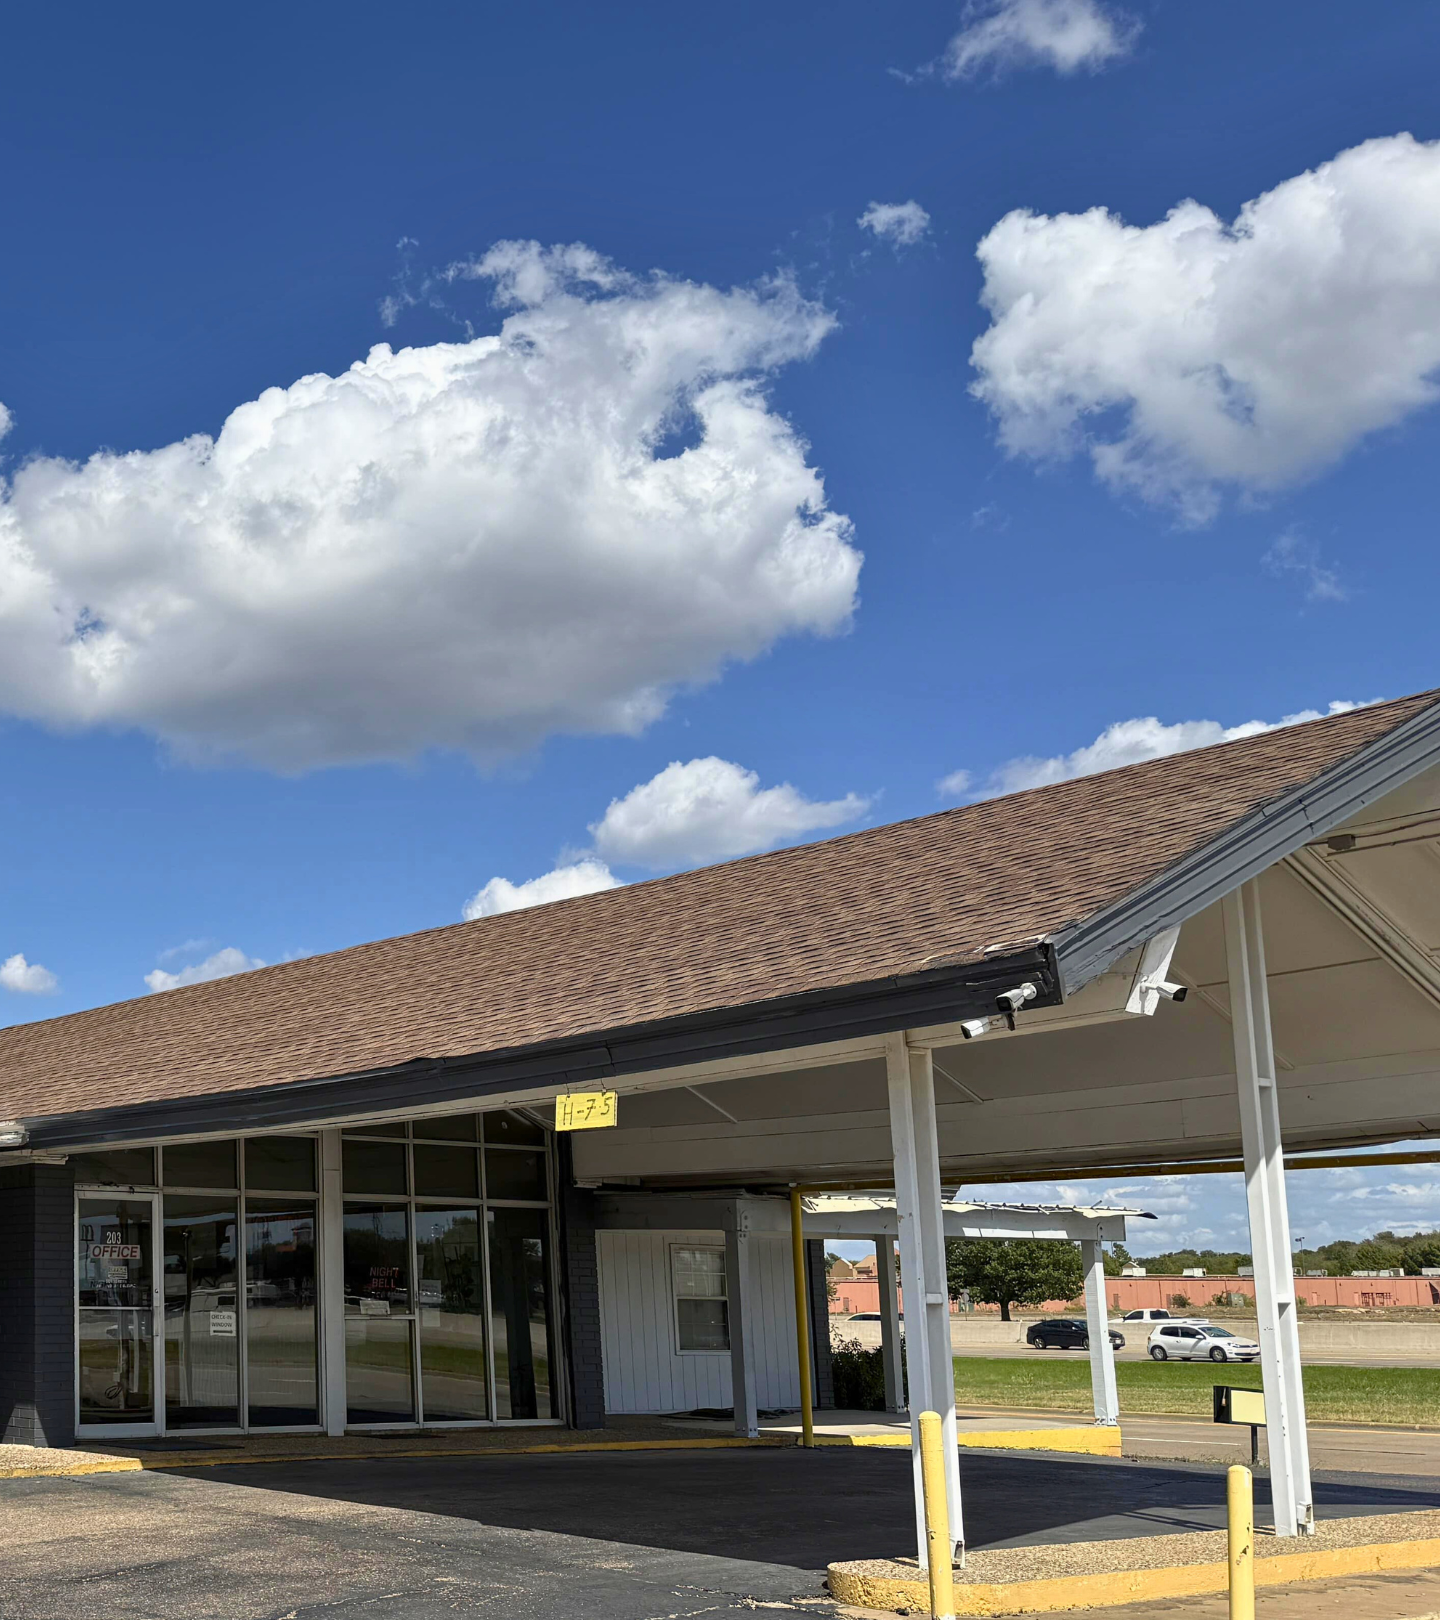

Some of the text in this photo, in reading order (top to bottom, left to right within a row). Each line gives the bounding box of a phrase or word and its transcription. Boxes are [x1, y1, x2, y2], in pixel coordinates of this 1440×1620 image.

[106, 1231, 122, 1244] 203
[92, 1245, 139, 1258] OFFICE
[369, 1267, 399, 1277] NIGHT
[372, 1278, 396, 1288] BELL
